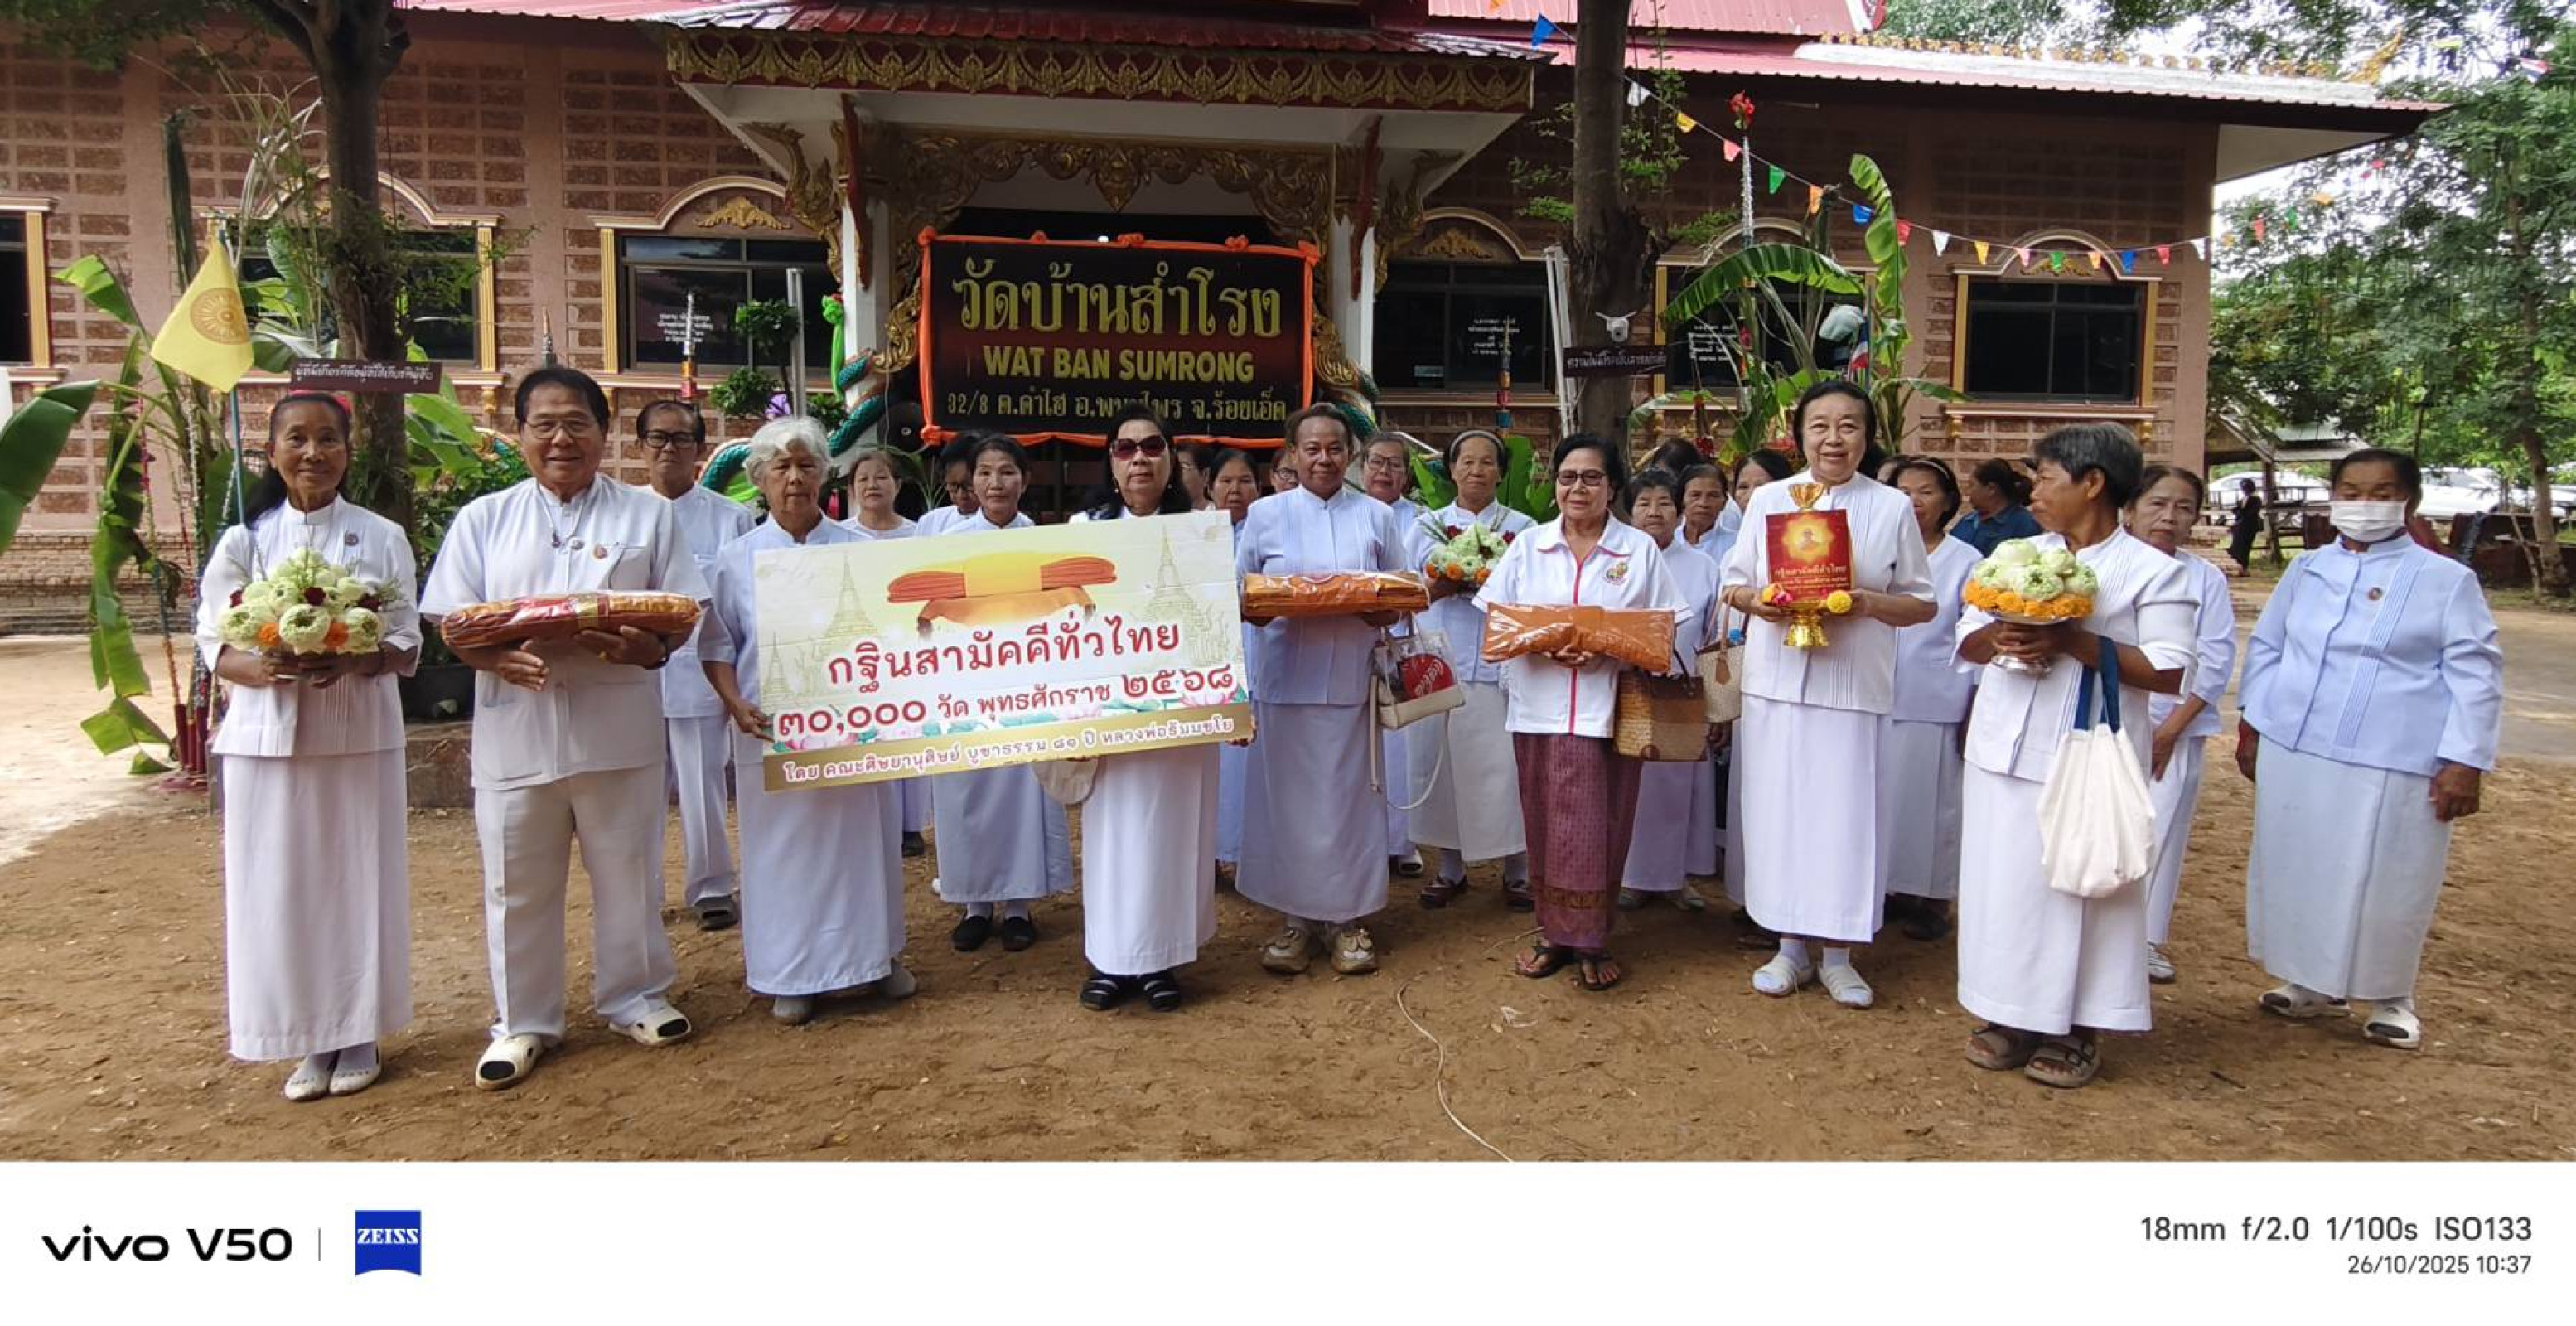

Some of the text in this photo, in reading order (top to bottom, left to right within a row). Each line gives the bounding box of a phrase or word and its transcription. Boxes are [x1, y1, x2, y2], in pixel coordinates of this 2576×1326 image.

[952, 256, 1283, 338] วัดบ้านสำโรง
[984, 346, 1254, 383] WAT BAN SUMRONG
[947, 390, 988, 416] 32/8
[1191, 385, 1286, 422] จ.ร้อยเอ็ด
[829, 611, 1180, 694] กฐินสามัคคีทั่วไทย
[779, 662, 1233, 737] ๓๐,๐๐๐ วัด พุทธศักราช ๒๕๖๘
[785, 763, 819, 781] โดย
[826, 745, 959, 778] คณะศิษยานุศิษย์
[968, 740, 1046, 765] บูชาธรรม
[1054, 738, 1077, 749] ๘๑
[1084, 729, 1095, 746] ปี
